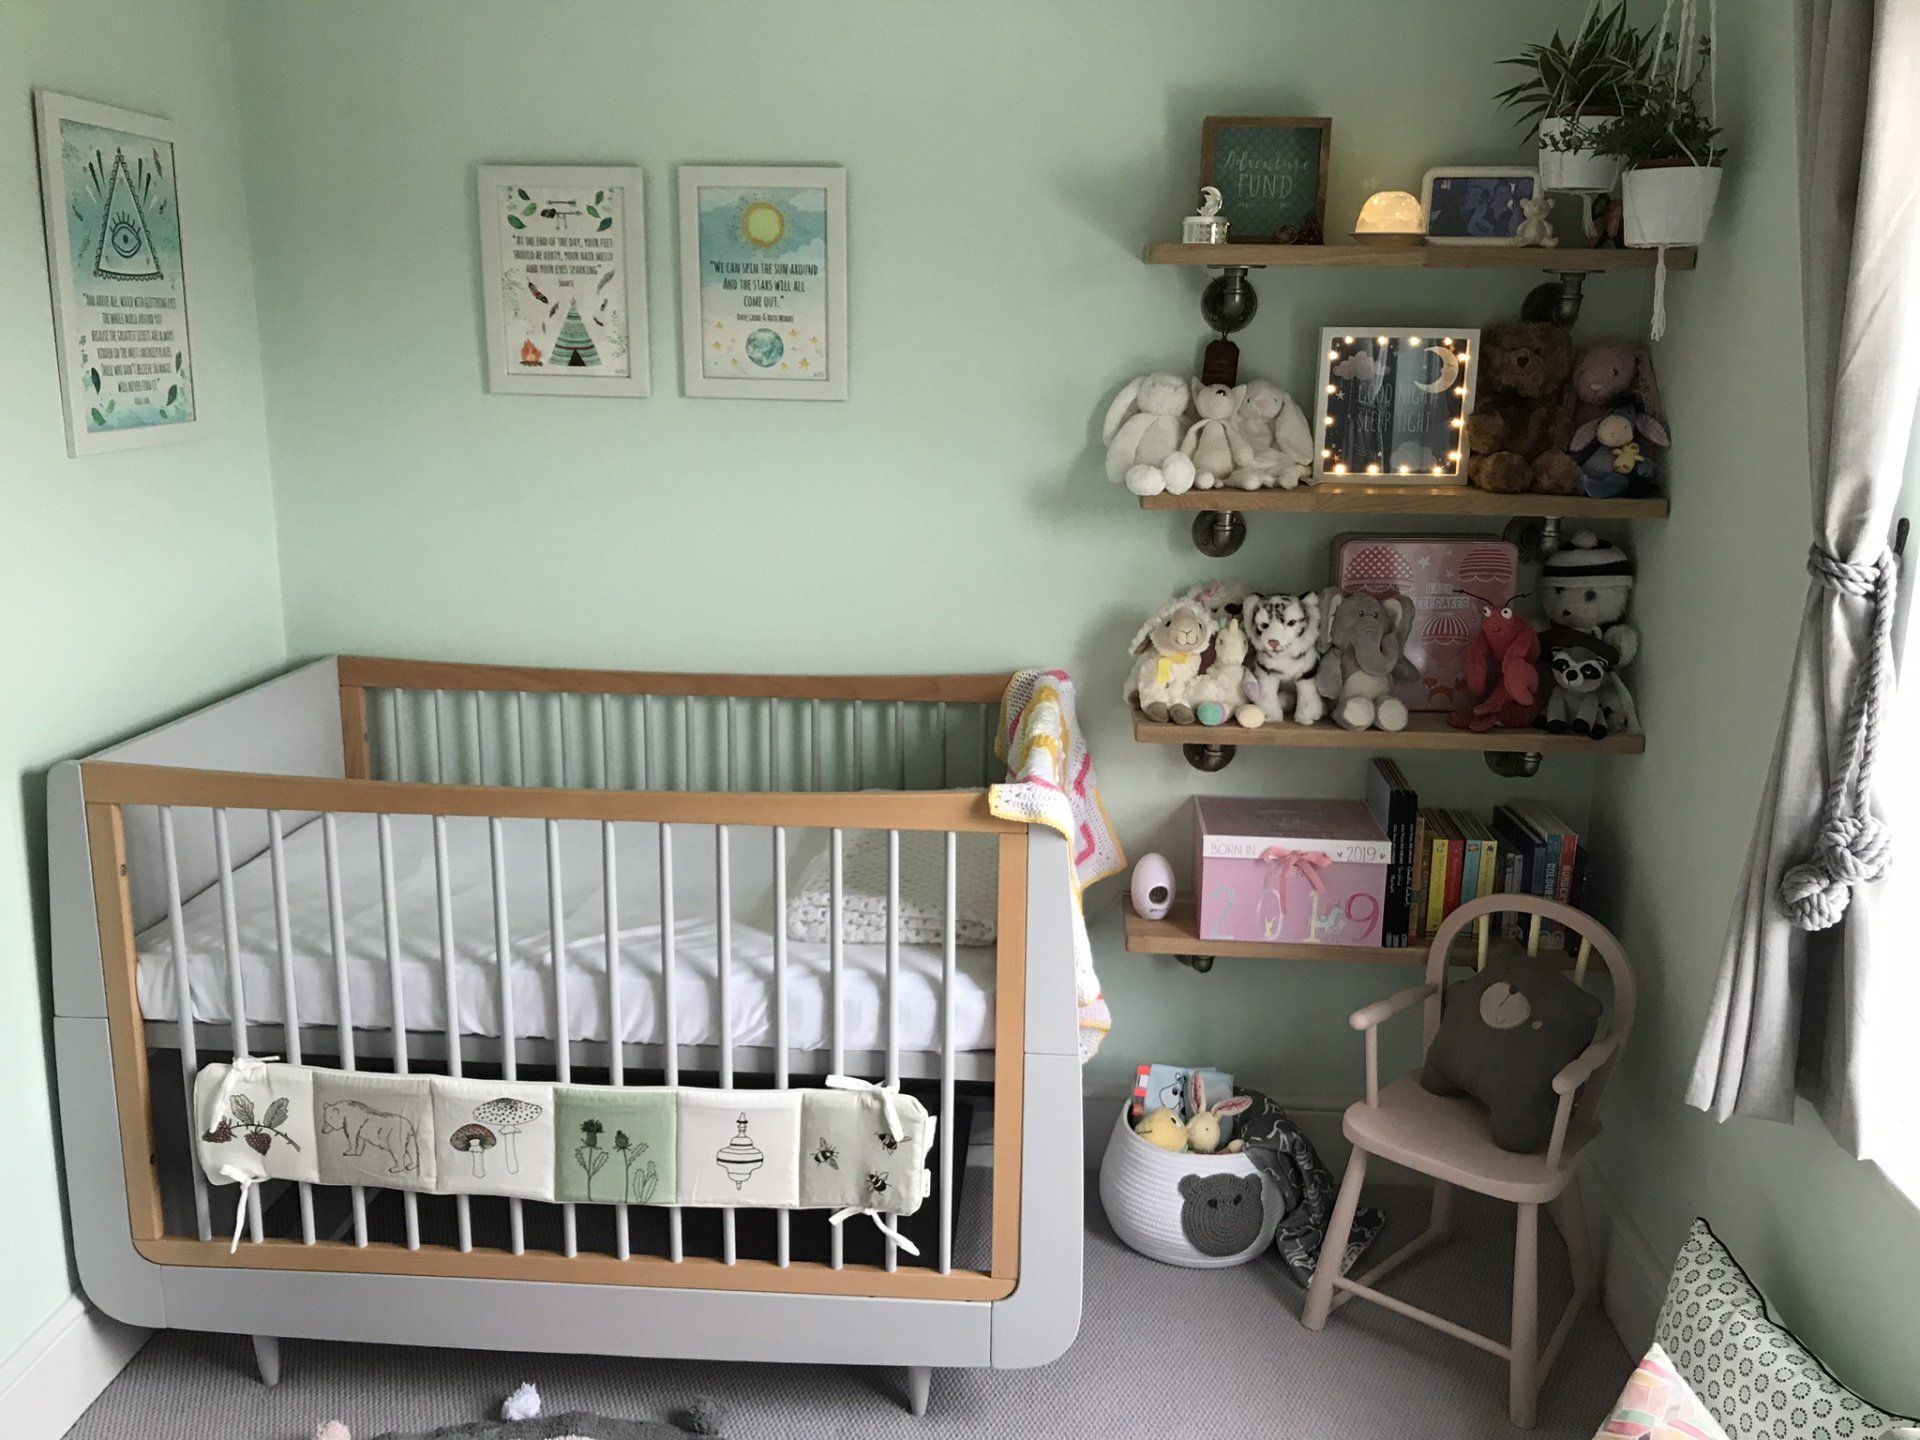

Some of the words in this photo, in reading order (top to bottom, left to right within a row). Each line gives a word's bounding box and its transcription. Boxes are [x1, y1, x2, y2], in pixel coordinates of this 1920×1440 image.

[1223, 149, 1309, 172] Adventure
[1237, 173, 1293, 200] FUND
[584, 238, 599, 249] YOUR
[564, 251, 579, 261] YOUR
[540, 264, 554, 275] YOUR
[726, 262, 740, 274] CAN
[742, 262, 759, 275] SPIN
[761, 262, 772, 275] THE
[774, 263, 788, 275] SUN
[790, 263, 818, 276] AROUND
[722, 277, 738, 290] AND
[740, 279, 751, 291] THE
[752, 279, 773, 292] STARS
[774, 280, 791, 292] WILL
[793, 280, 805, 293] ALL
[744, 295, 762, 308] COME
[1358, 382, 1393, 404] GOOD
[1357, 411, 1391, 433] SLEEP
[1397, 411, 1430, 433] TIGHT
[1210, 843, 1244, 855] BORN
[1246, 845, 1256, 856] IN
[1346, 846, 1377, 862] 2019
